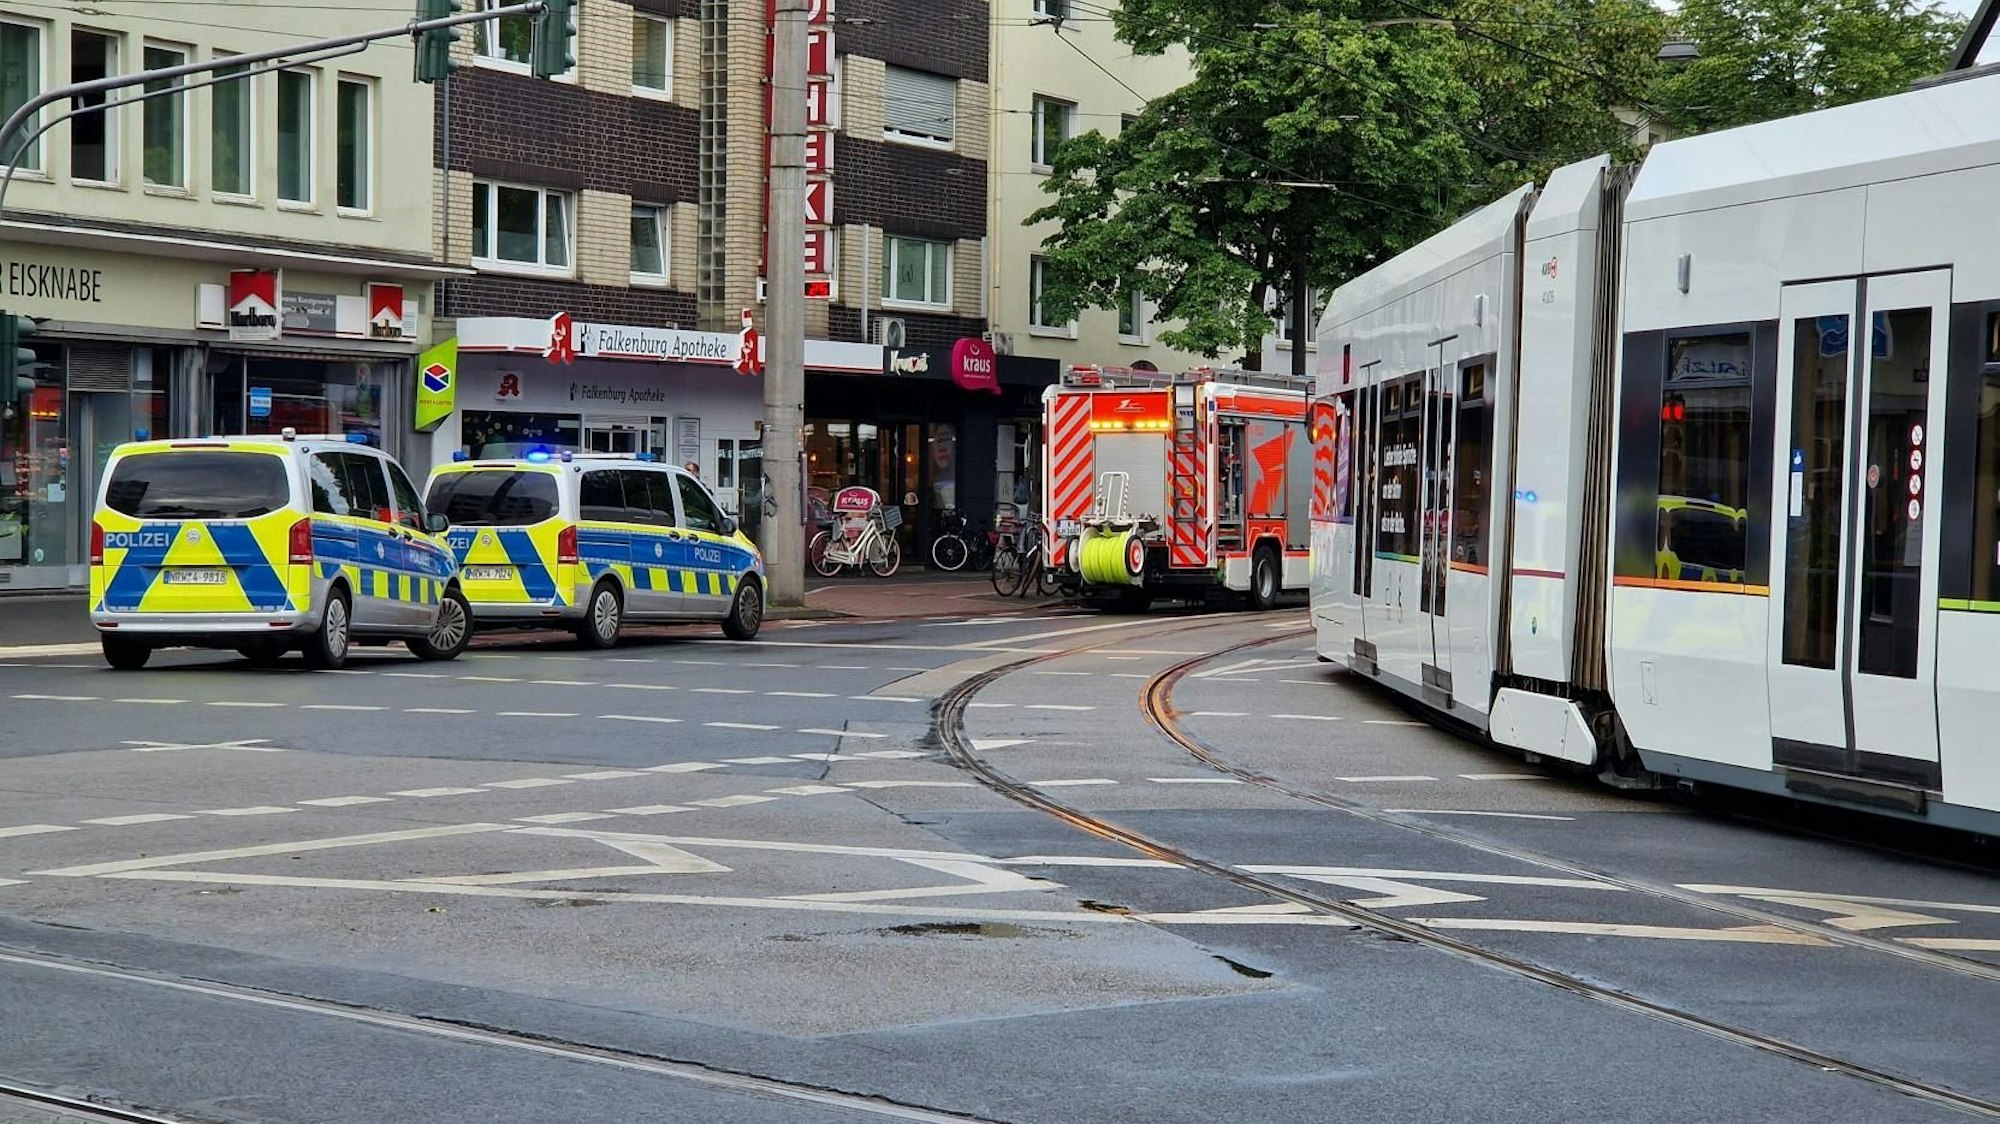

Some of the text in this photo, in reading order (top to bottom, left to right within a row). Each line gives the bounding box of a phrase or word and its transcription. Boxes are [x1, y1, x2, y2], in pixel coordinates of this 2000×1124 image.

[10, 262, 101, 302] EISKNABE
[230, 306, 276, 329] Marlboro
[599, 330, 726, 359] Falkenburg Apotheke
[963, 355, 991, 373] kraus
[581, 384, 665, 404] Falkenburg Apotheke
[105, 532, 170, 548] POLIZEI
[694, 546, 721, 563] POLIZEI
